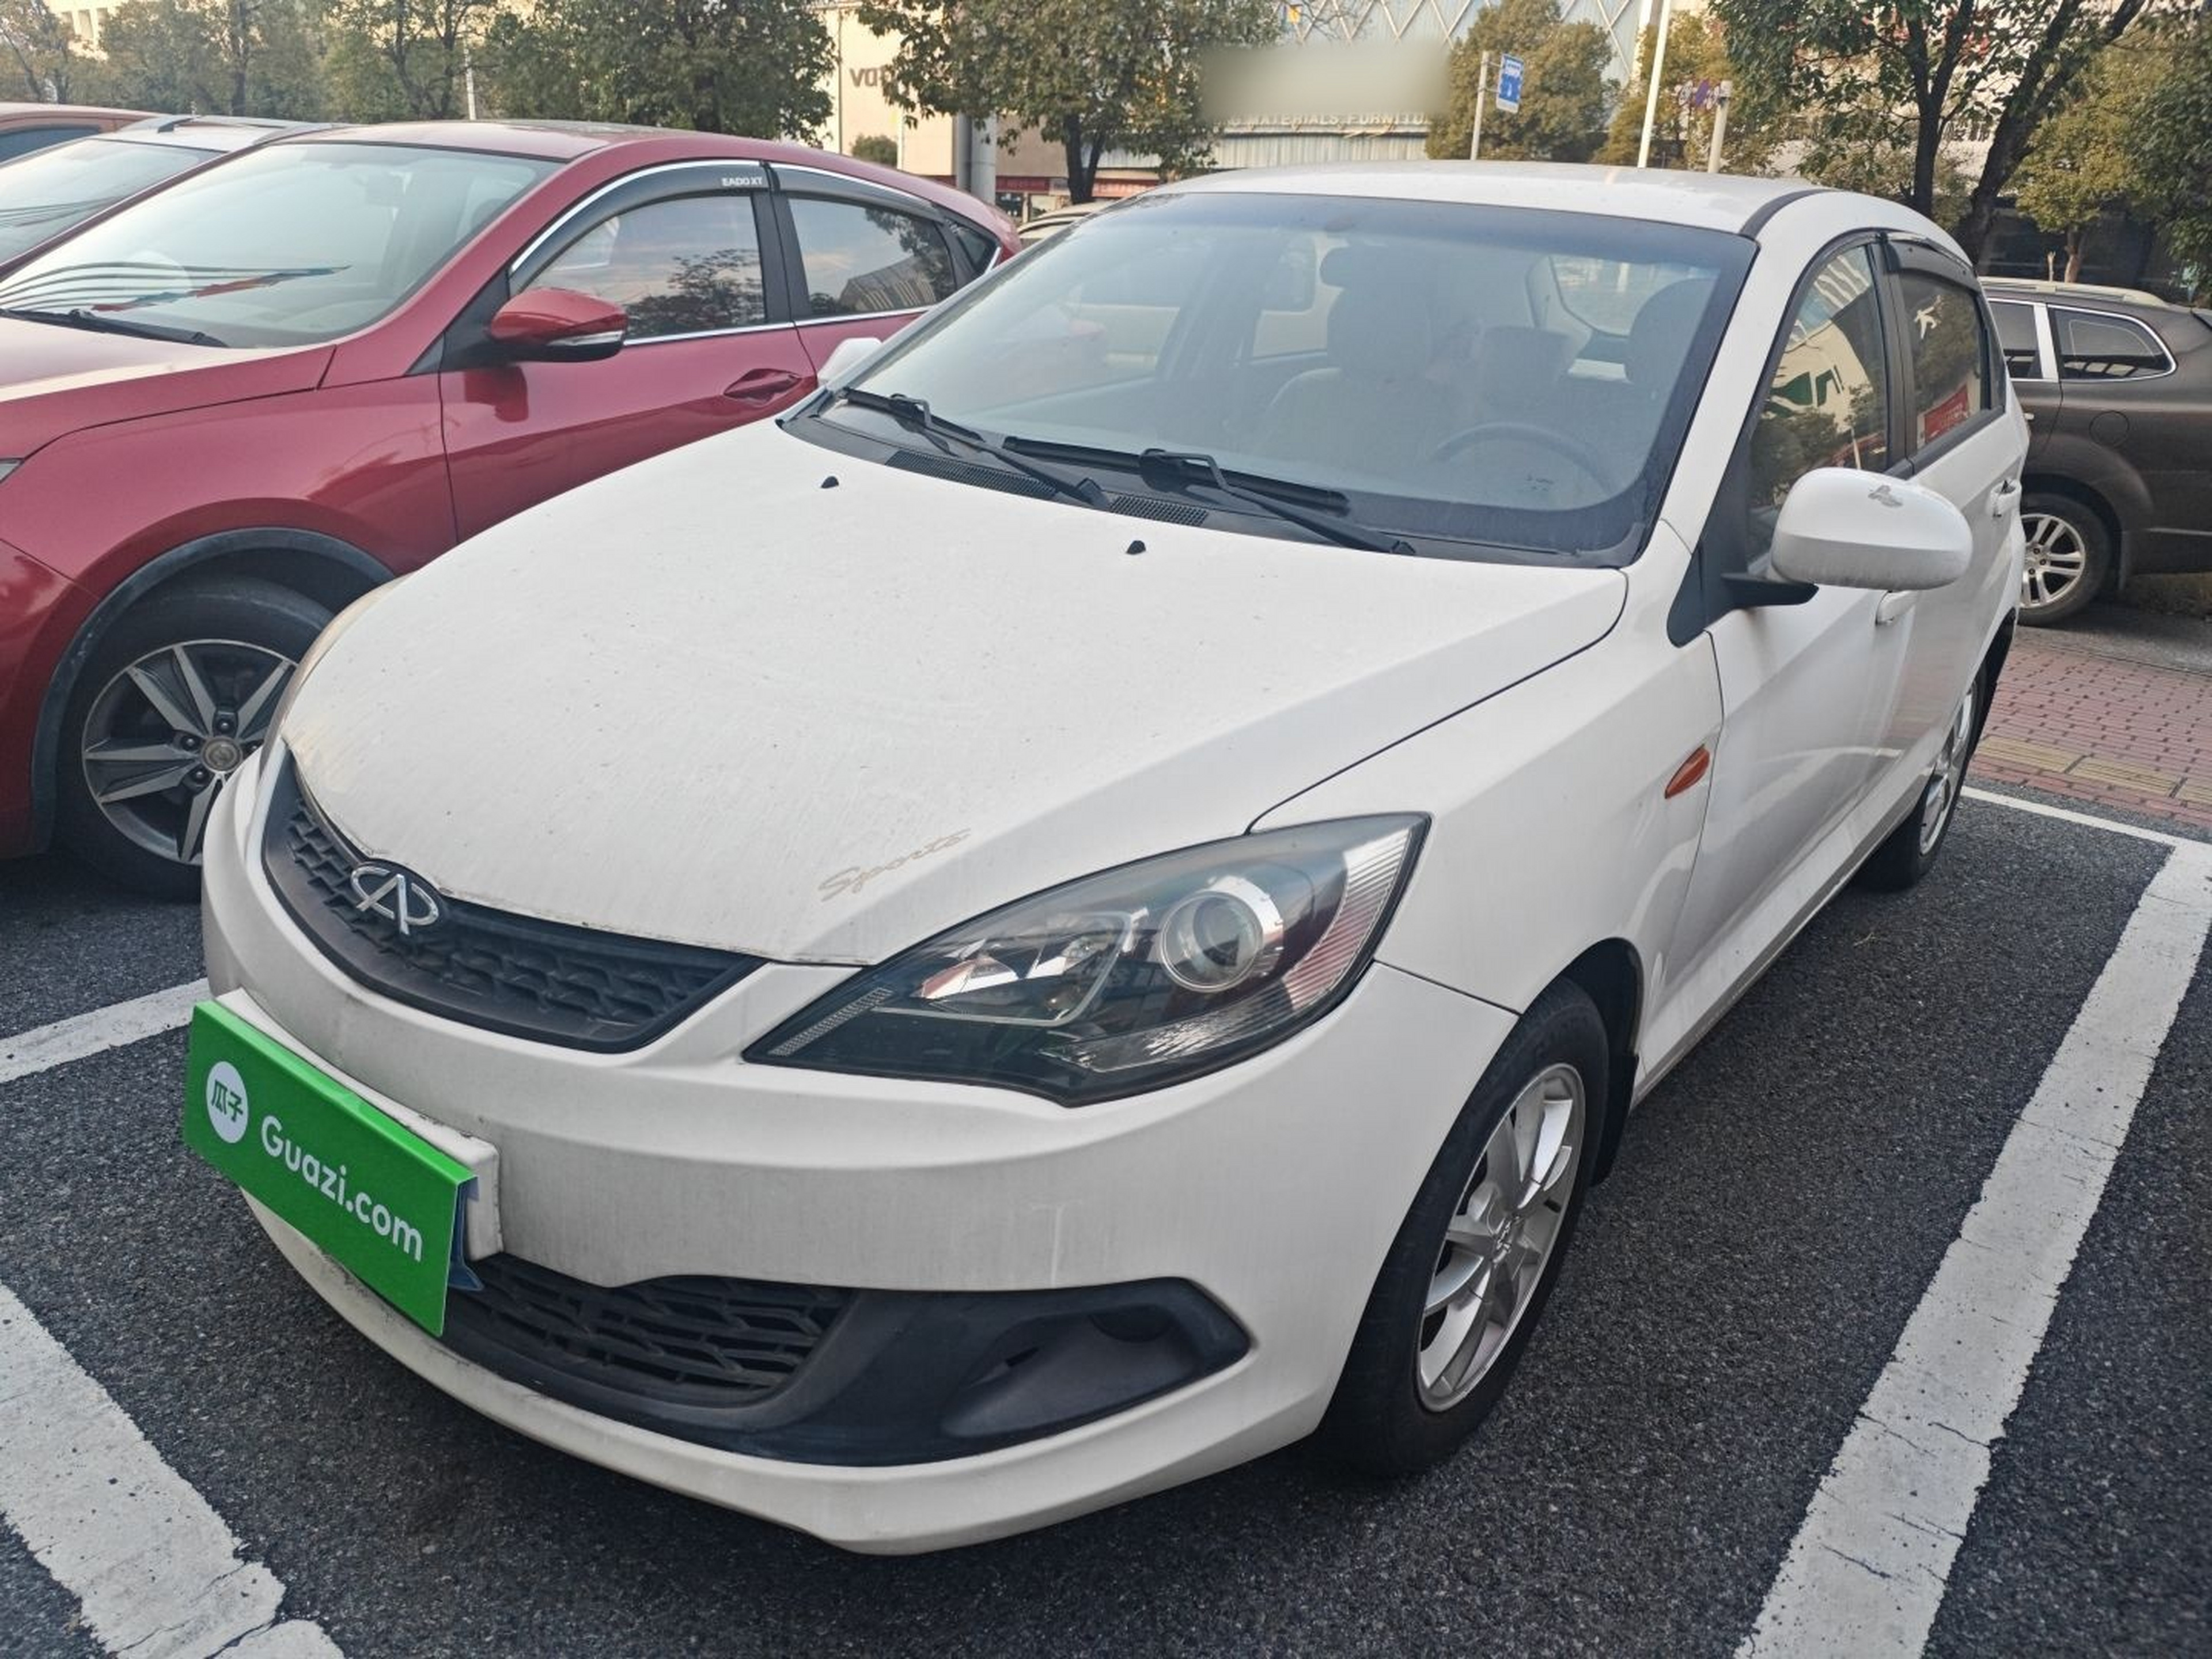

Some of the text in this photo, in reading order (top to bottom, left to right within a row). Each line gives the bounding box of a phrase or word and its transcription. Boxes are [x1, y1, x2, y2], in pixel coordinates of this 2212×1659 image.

[751, 176, 762, 185] XT
[818, 828, 971, 902] Sports
[211, 1080, 244, 1123] 瓜子
[261, 1115, 423, 1262] Guazi.com
